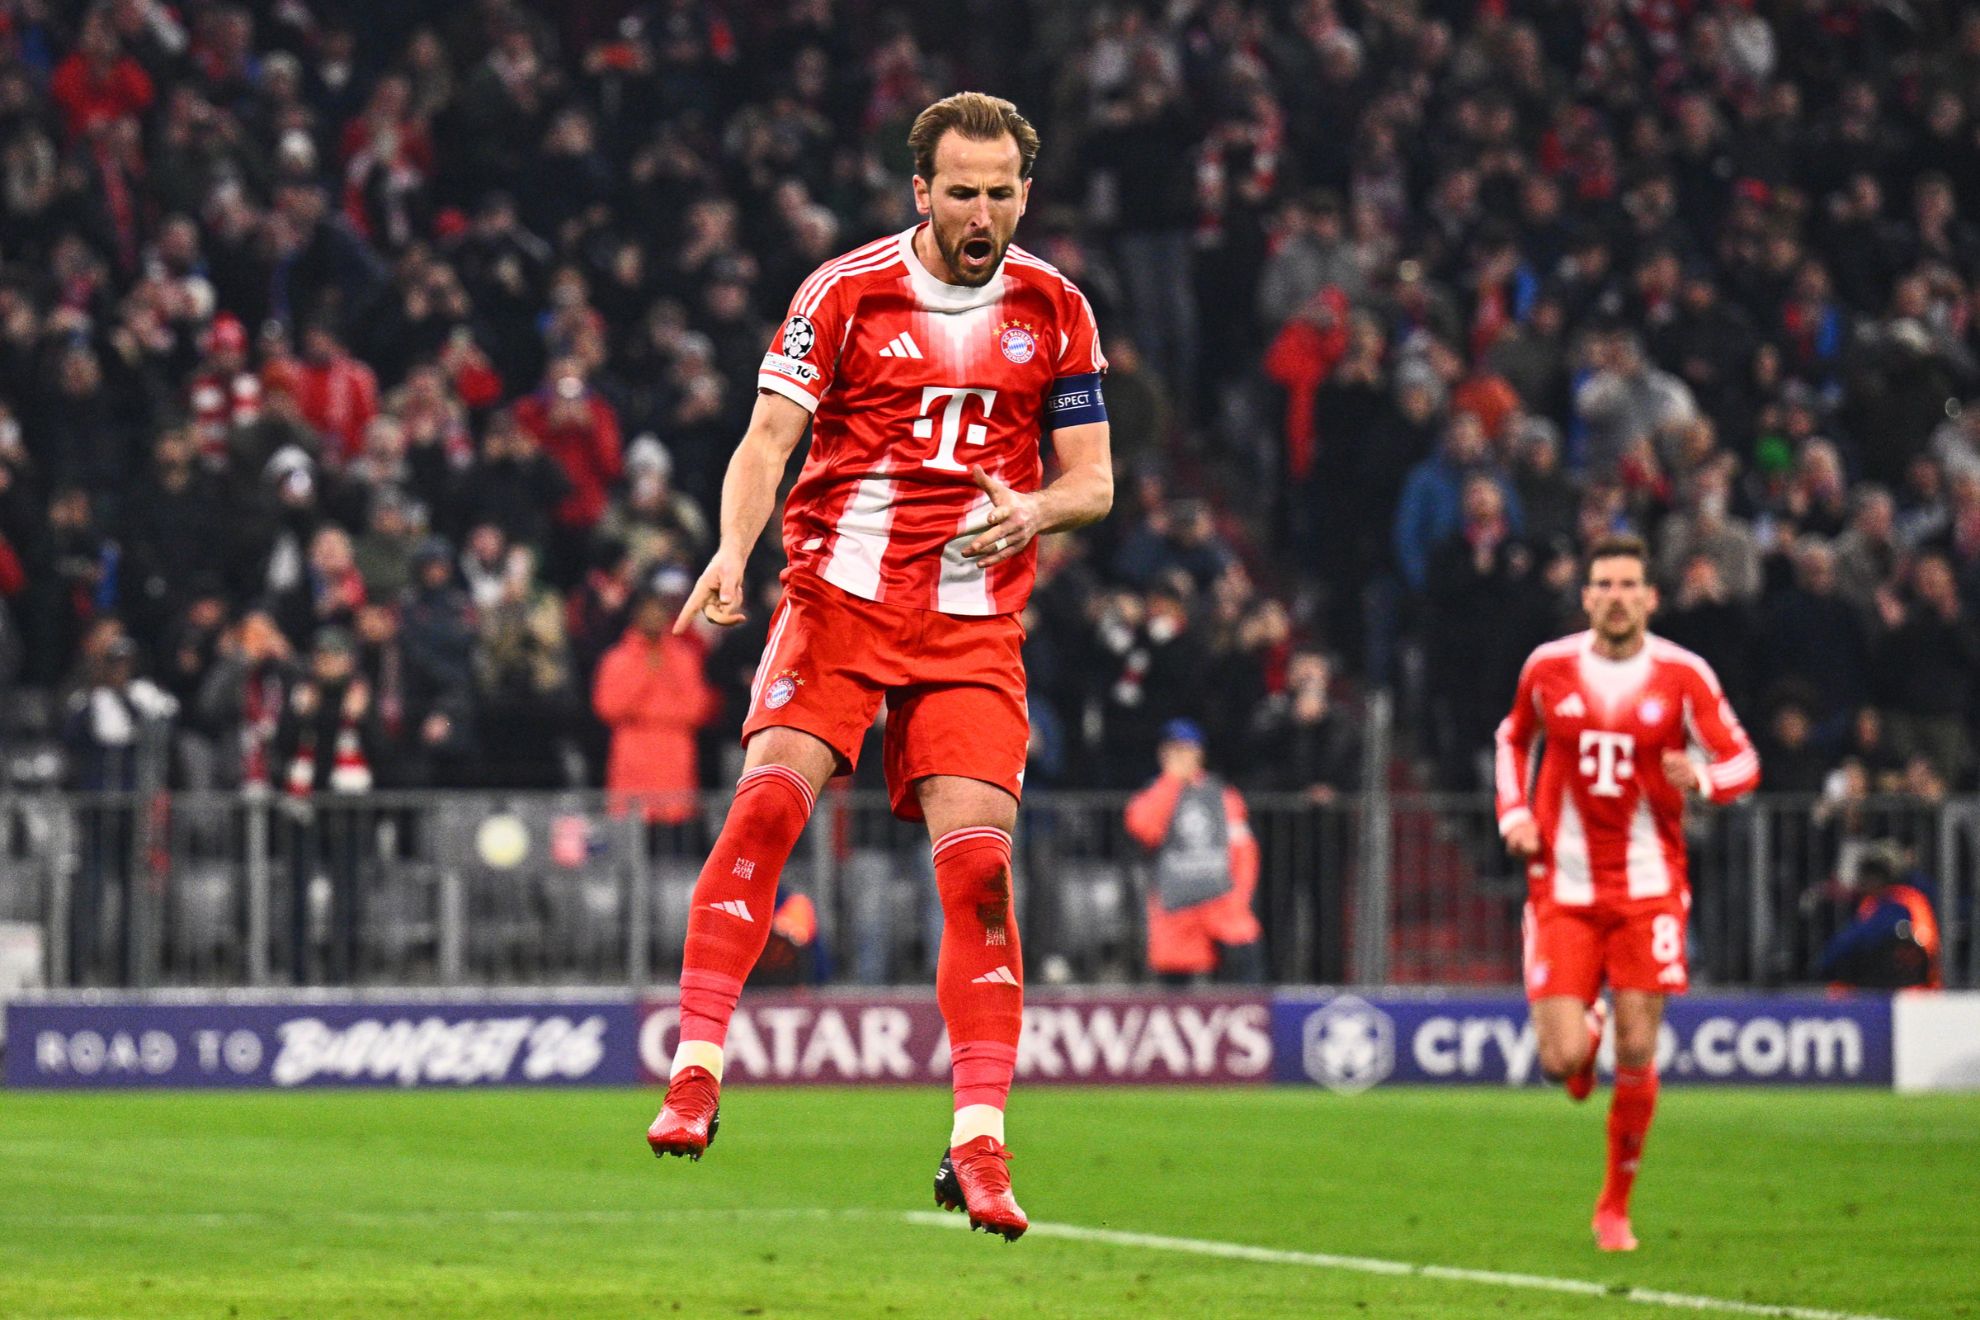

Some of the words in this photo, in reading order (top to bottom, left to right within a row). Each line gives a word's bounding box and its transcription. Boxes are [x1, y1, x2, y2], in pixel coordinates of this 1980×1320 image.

[913, 386, 997, 471] T
[1048, 394, 1089, 408] RESPECT
[1579, 729, 1635, 797] T
[1652, 914, 1680, 963] 8
[35, 1029, 178, 1075] ROAD
[190, 1029, 264, 1074] TO
[929, 1005, 1273, 1077] RWAYS
[1413, 1016, 1863, 1086] cry.com
